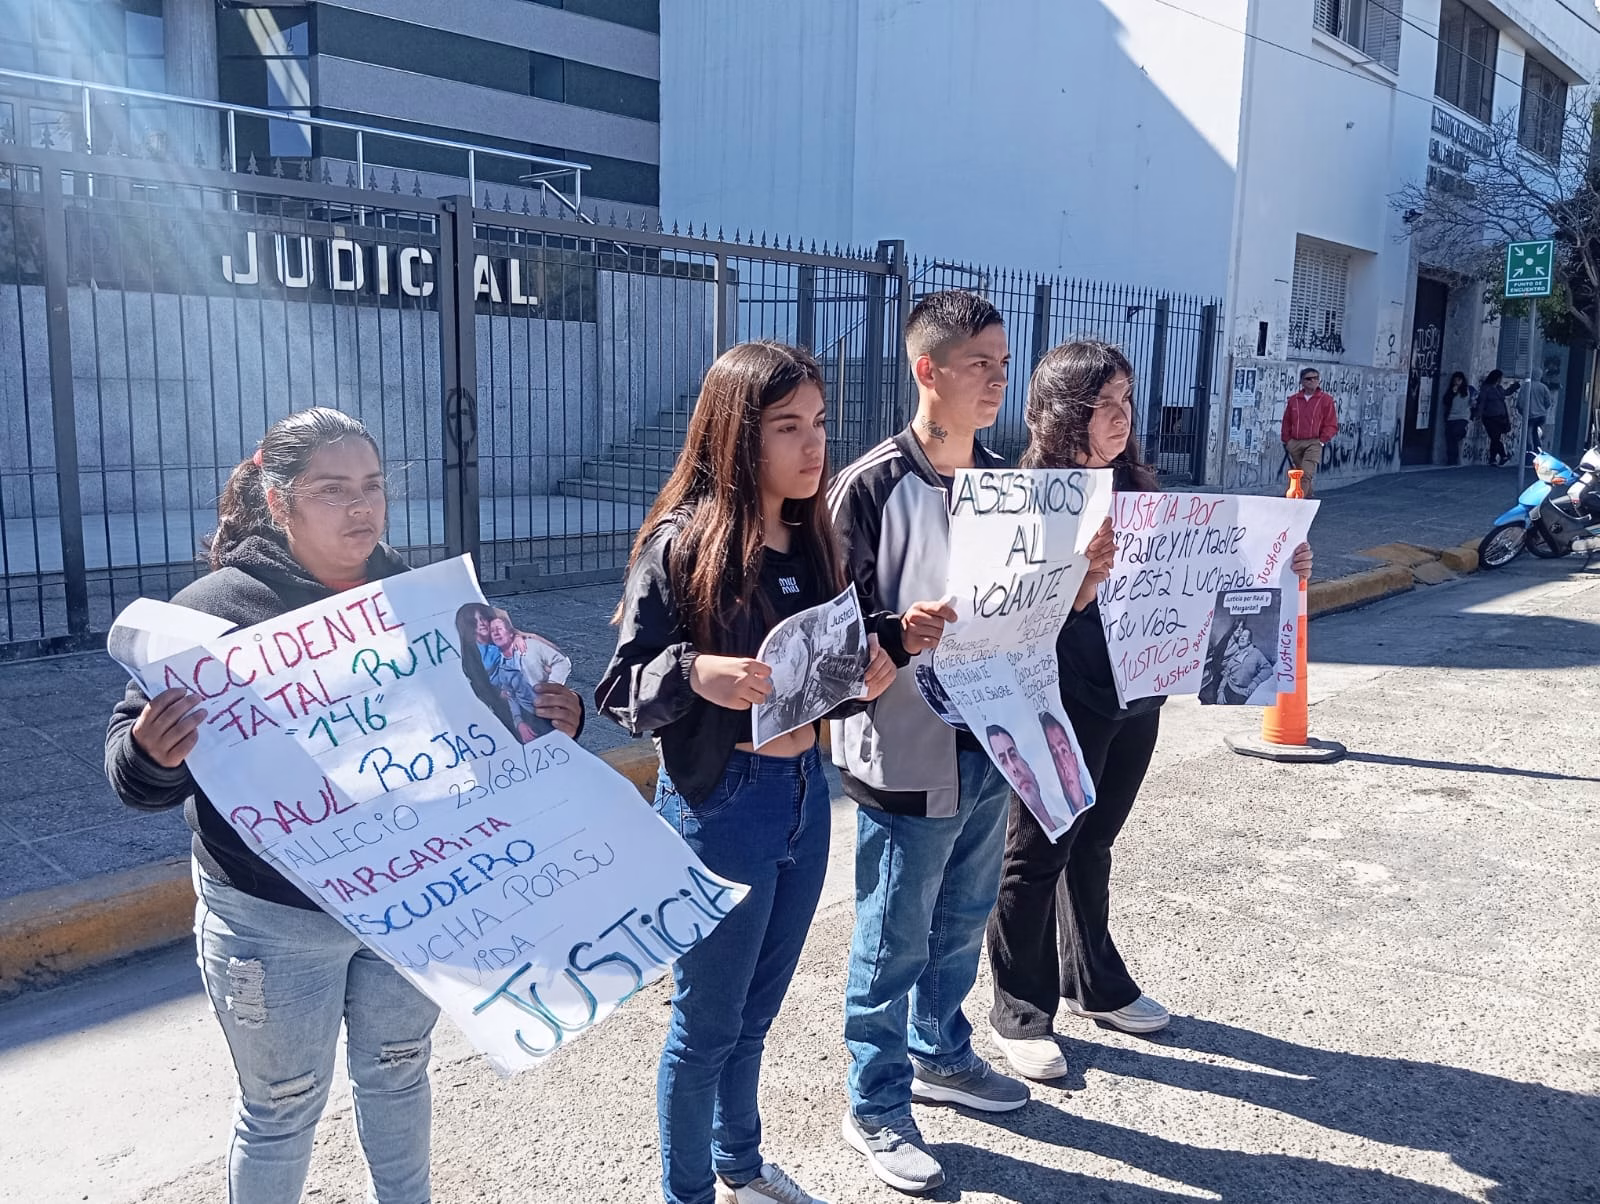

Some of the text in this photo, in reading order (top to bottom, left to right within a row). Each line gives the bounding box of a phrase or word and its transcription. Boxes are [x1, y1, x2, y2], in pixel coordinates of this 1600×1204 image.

[222, 232, 538, 305] JUDICAL
[1005, 523, 1046, 566] AL
[973, 564, 1072, 618] VOLANTE
[206, 628, 462, 740] FATAL RUTA
[230, 723, 497, 844] RAUL ROJAS
[448, 743, 571, 809] 23/08/25
[343, 840, 535, 935] ESCUDERO
[503, 862, 580, 905] POR
[573, 841, 616, 875] SU
